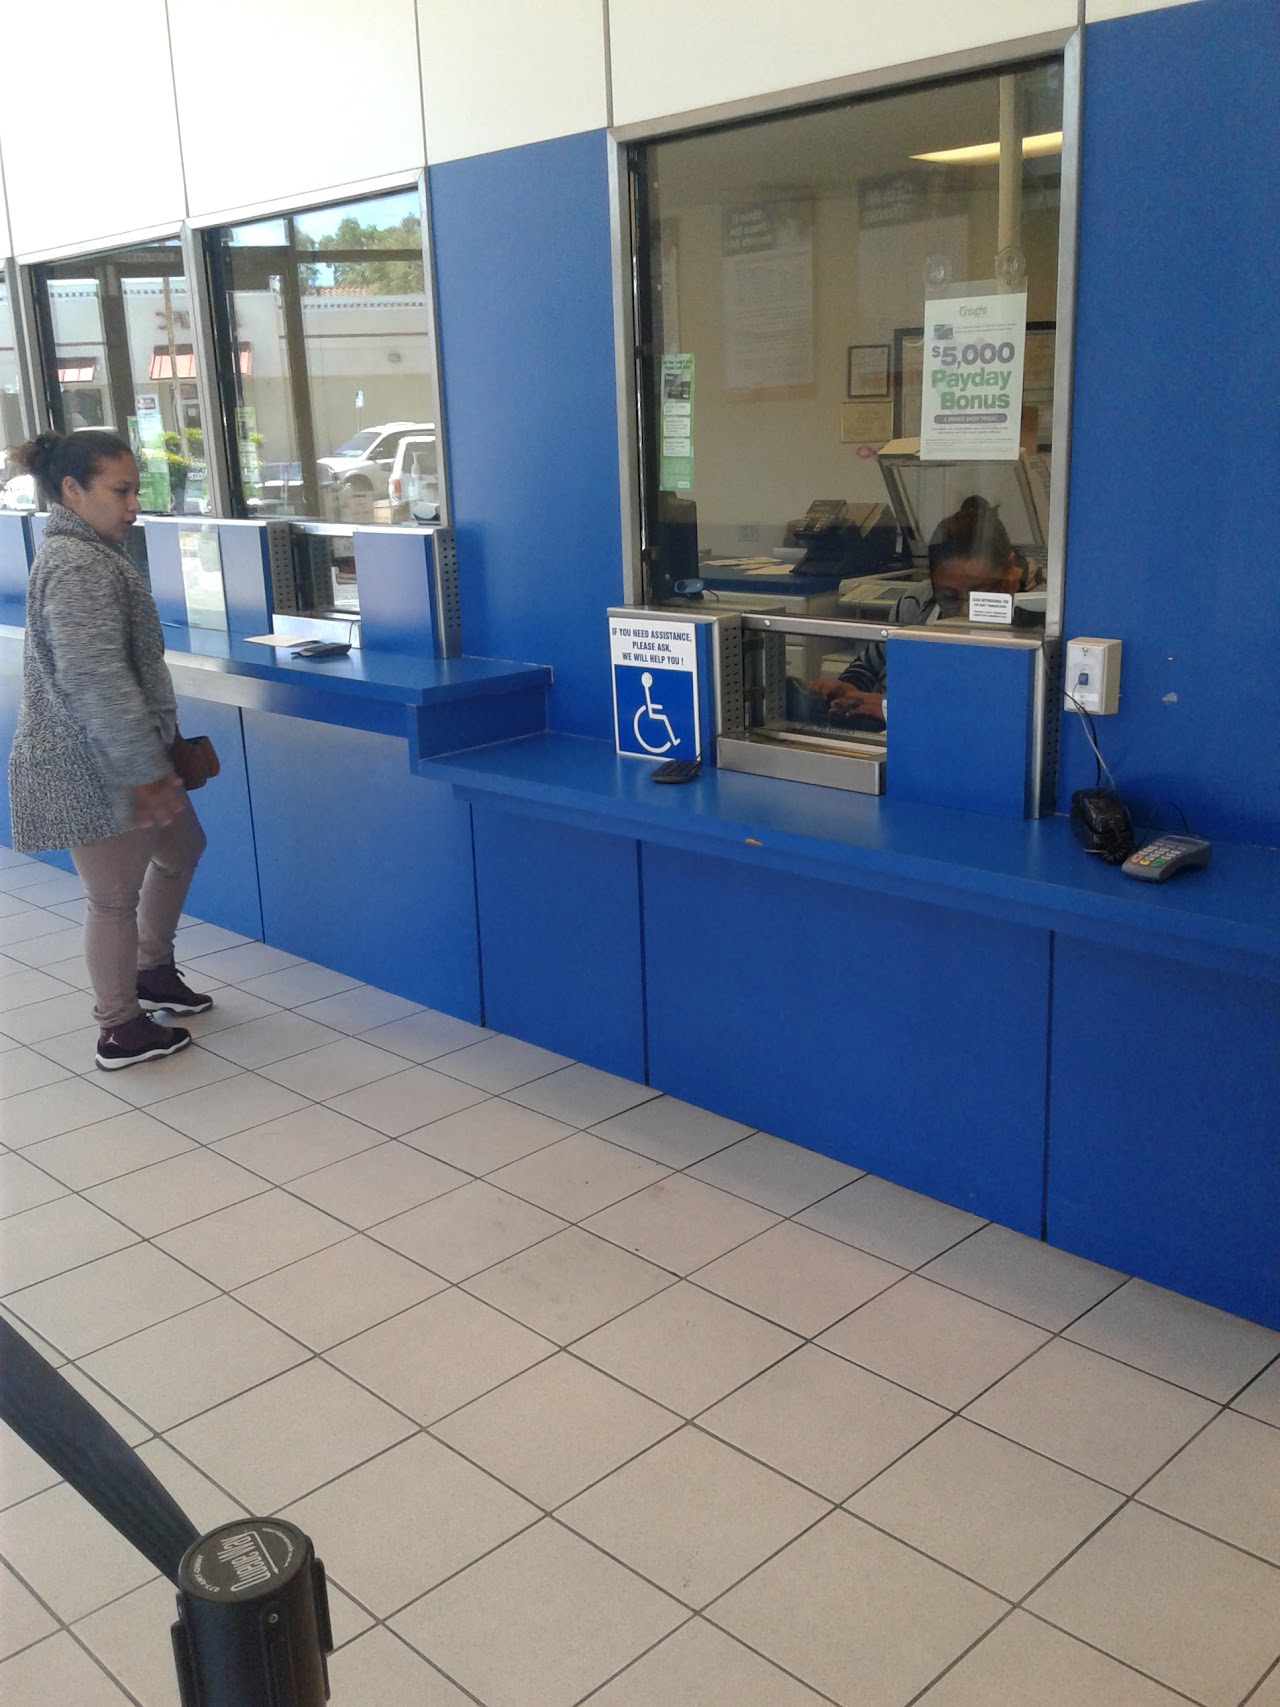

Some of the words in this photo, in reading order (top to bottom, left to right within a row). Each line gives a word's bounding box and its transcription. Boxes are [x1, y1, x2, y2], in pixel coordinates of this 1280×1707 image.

[931, 342, 1015, 369] $5,000
[931, 367, 1012, 392] Payday
[940, 391, 1010, 411] Bonus
[612, 627, 618, 636] IF
[619, 628, 631, 637] YOU
[633, 629, 649, 638] NEED
[632, 641, 655, 650] PLEASE
[622, 652, 632, 661] WE
[633, 653, 649, 662] WILL
[650, 654, 666, 664] HELP
[667, 655, 680, 665] YOU
